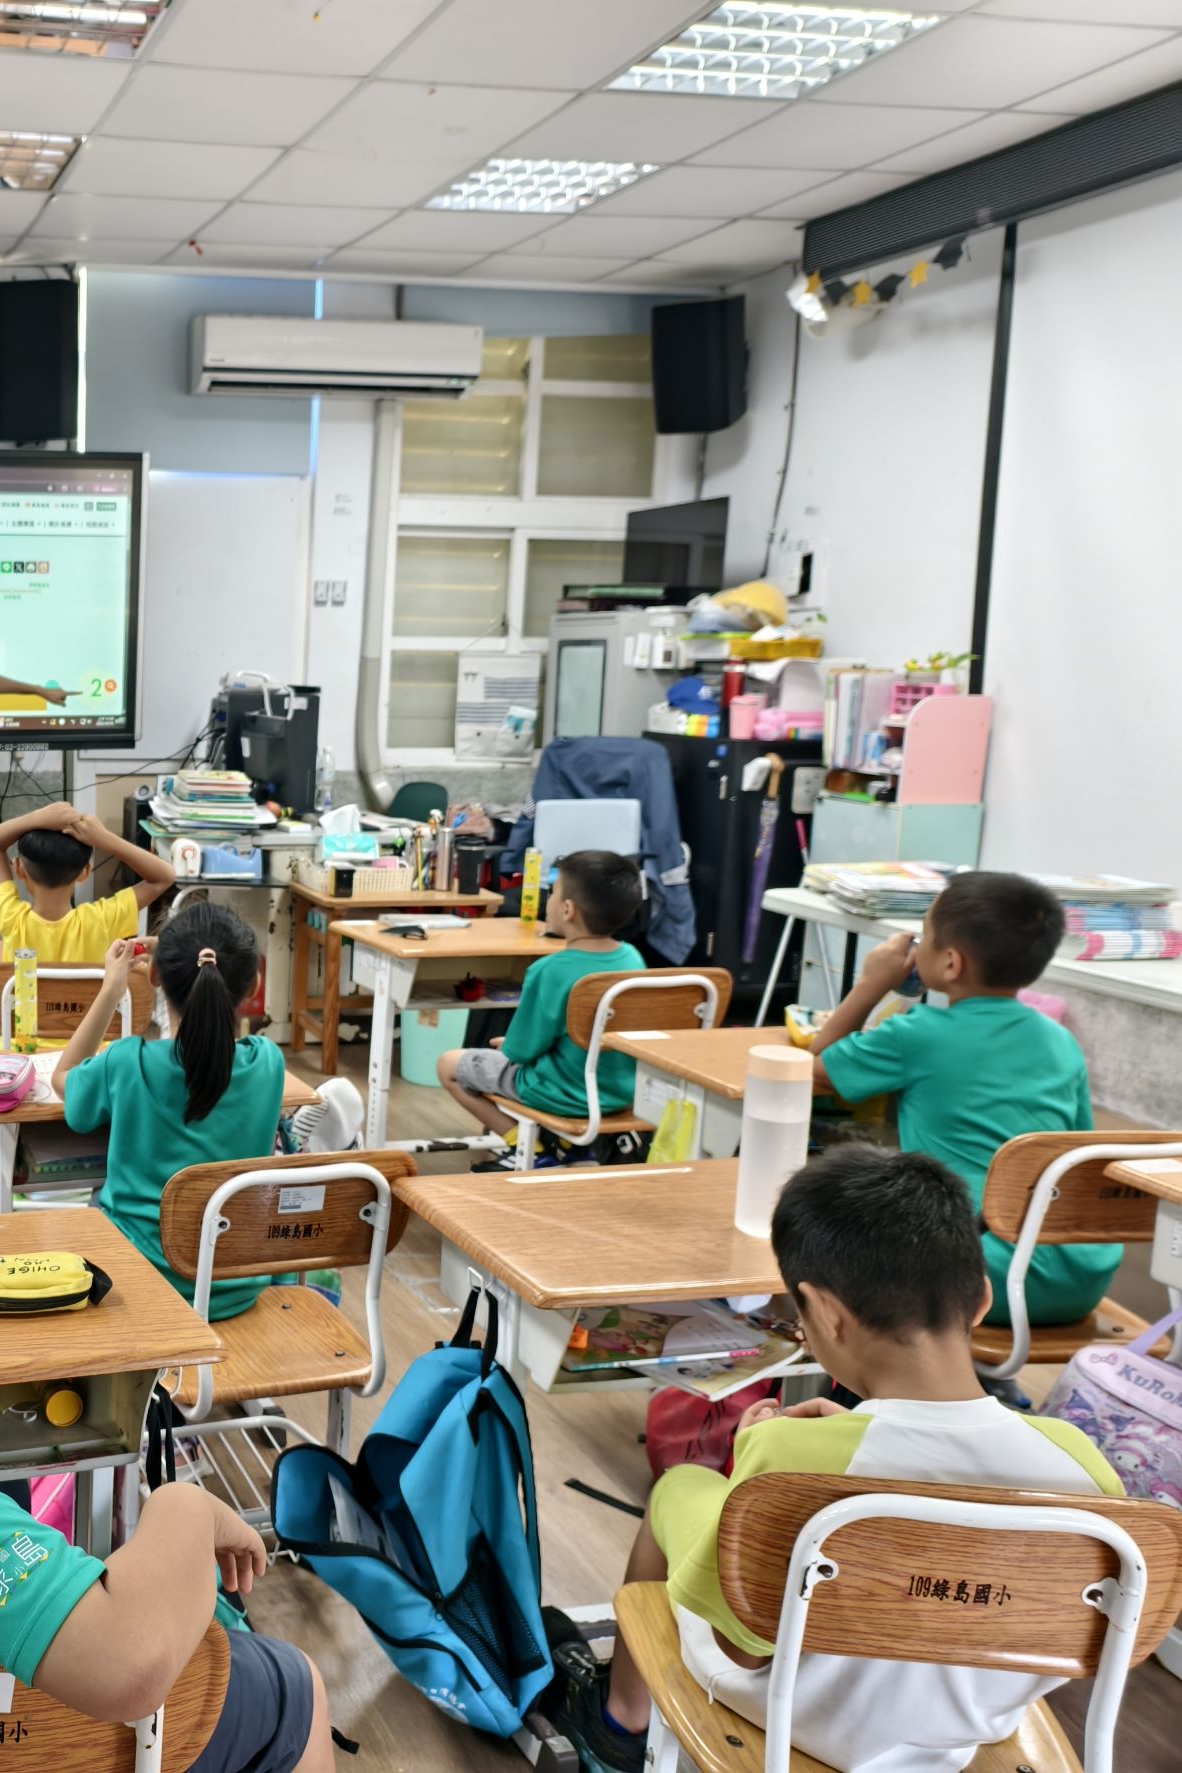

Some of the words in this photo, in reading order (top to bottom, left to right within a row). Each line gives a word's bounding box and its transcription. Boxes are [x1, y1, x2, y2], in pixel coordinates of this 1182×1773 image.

[91, 678, 102, 697] 2
[908, 1575, 1011, 1606] 109綠島國小
